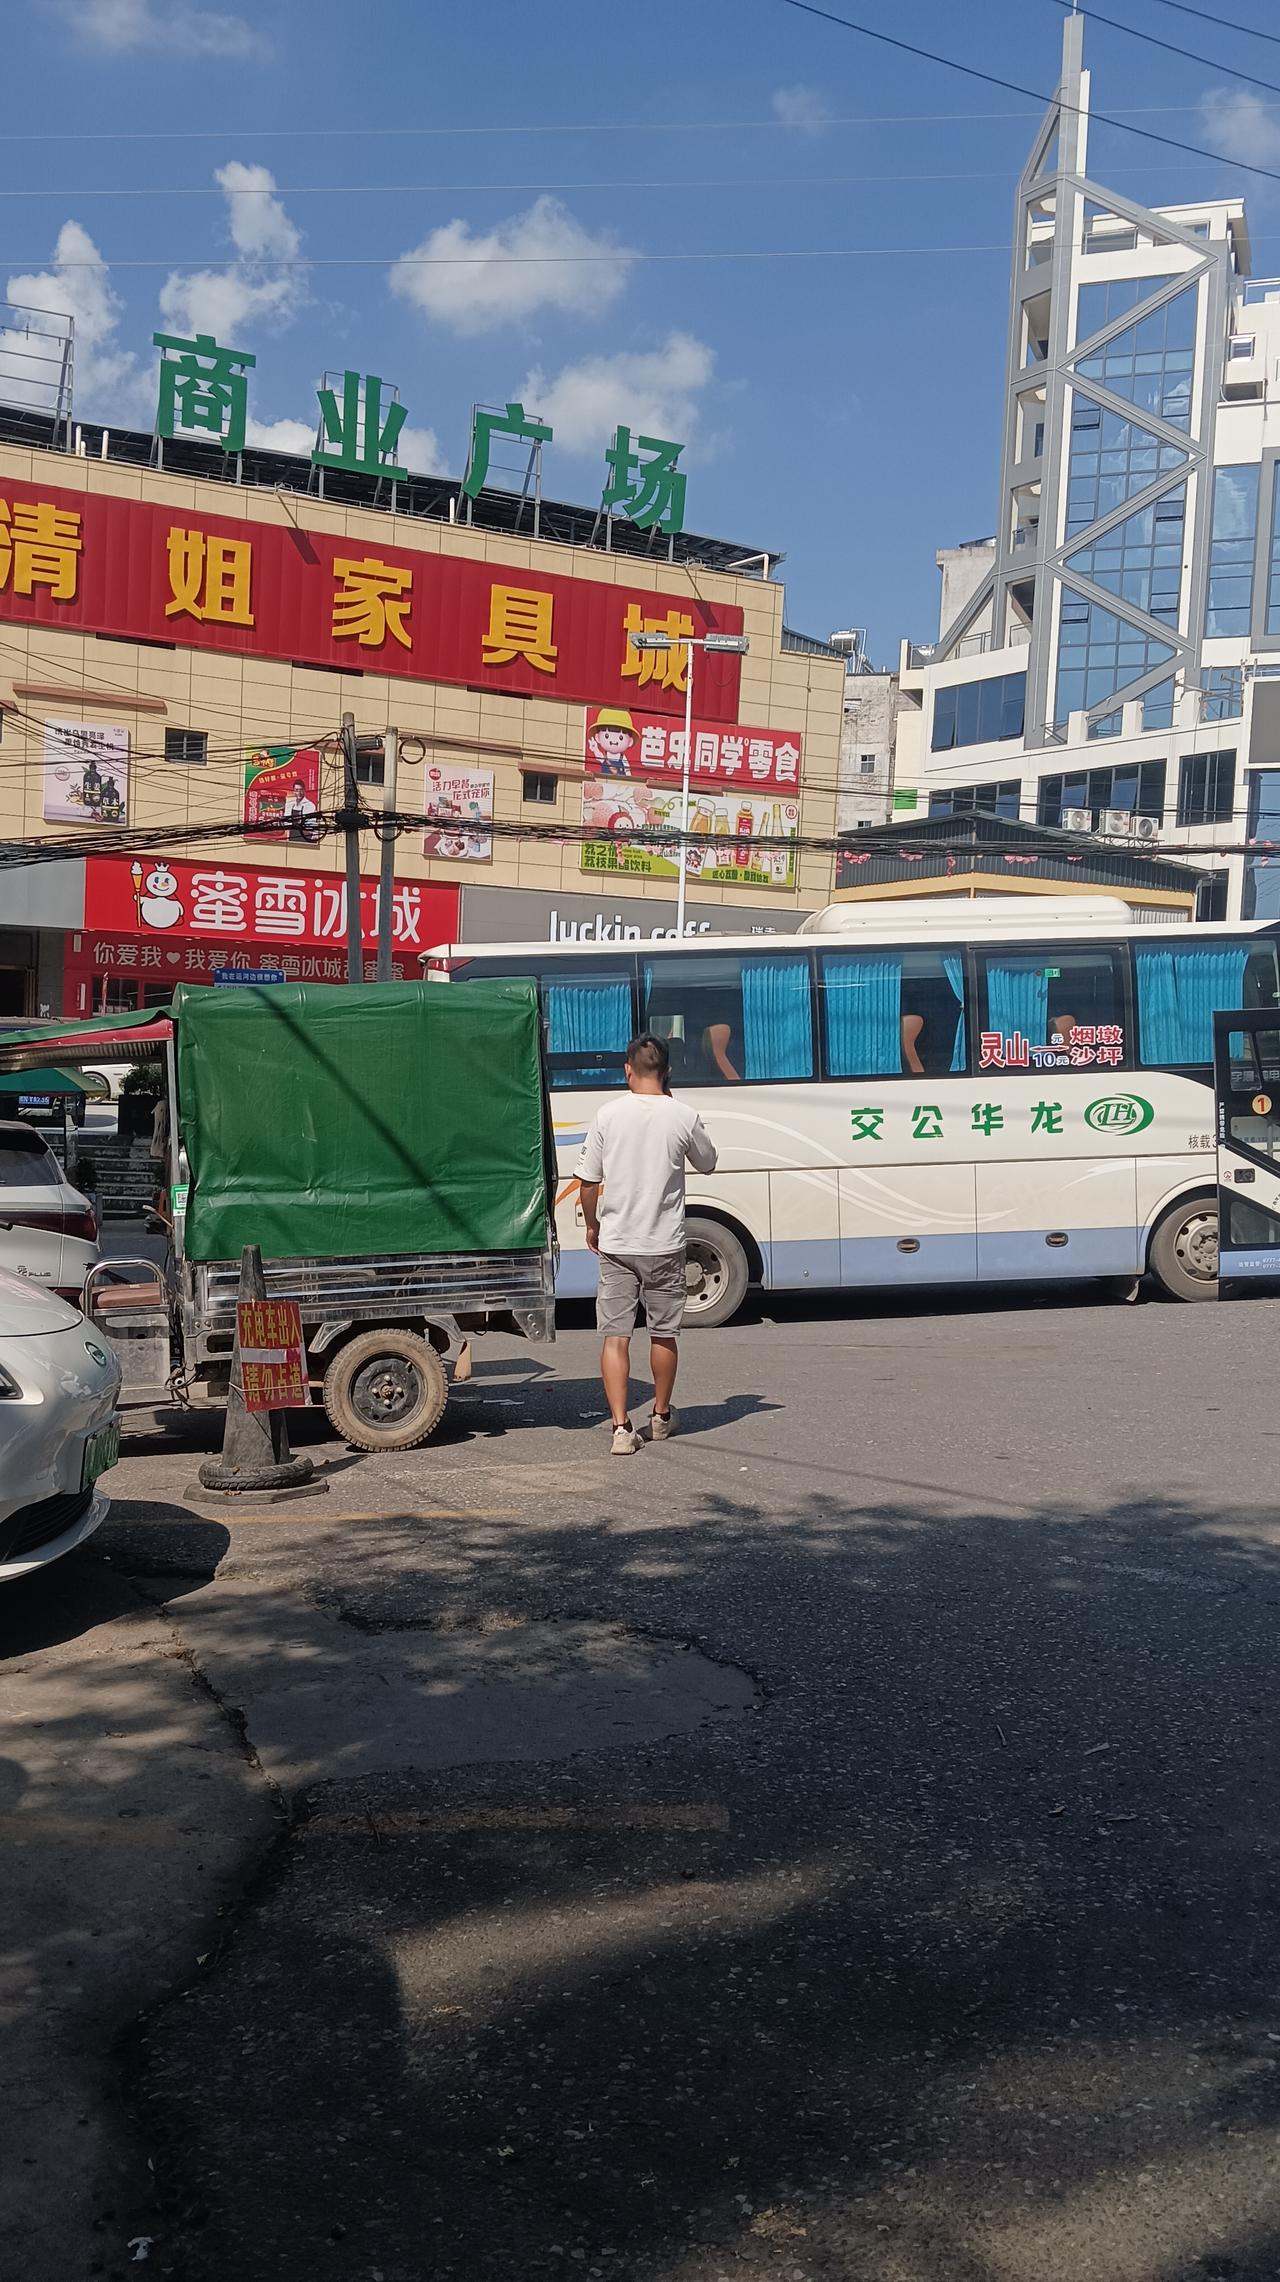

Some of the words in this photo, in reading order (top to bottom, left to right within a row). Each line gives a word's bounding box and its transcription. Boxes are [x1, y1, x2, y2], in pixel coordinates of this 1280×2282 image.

[153, 332, 686, 535] 商业广场
[0, 497, 695, 692] 清姐家具城
[640, 726, 800, 782] 芭乐同学零食
[189, 870, 422, 944] 蜜雪冰城
[93, 941, 162, 968] 你爱我
[184, 947, 251, 970] 我爱你
[979, 1031, 1030, 1069] 灵山
[1051, 1033, 1064, 1044] 元
[1069, 1025, 1123, 1046] 烟墩
[1069, 1046, 1124, 1067] 沙坪
[240, 1303, 301, 1348] 充电车出入
[245, 1361, 304, 1403] 请勿占道
